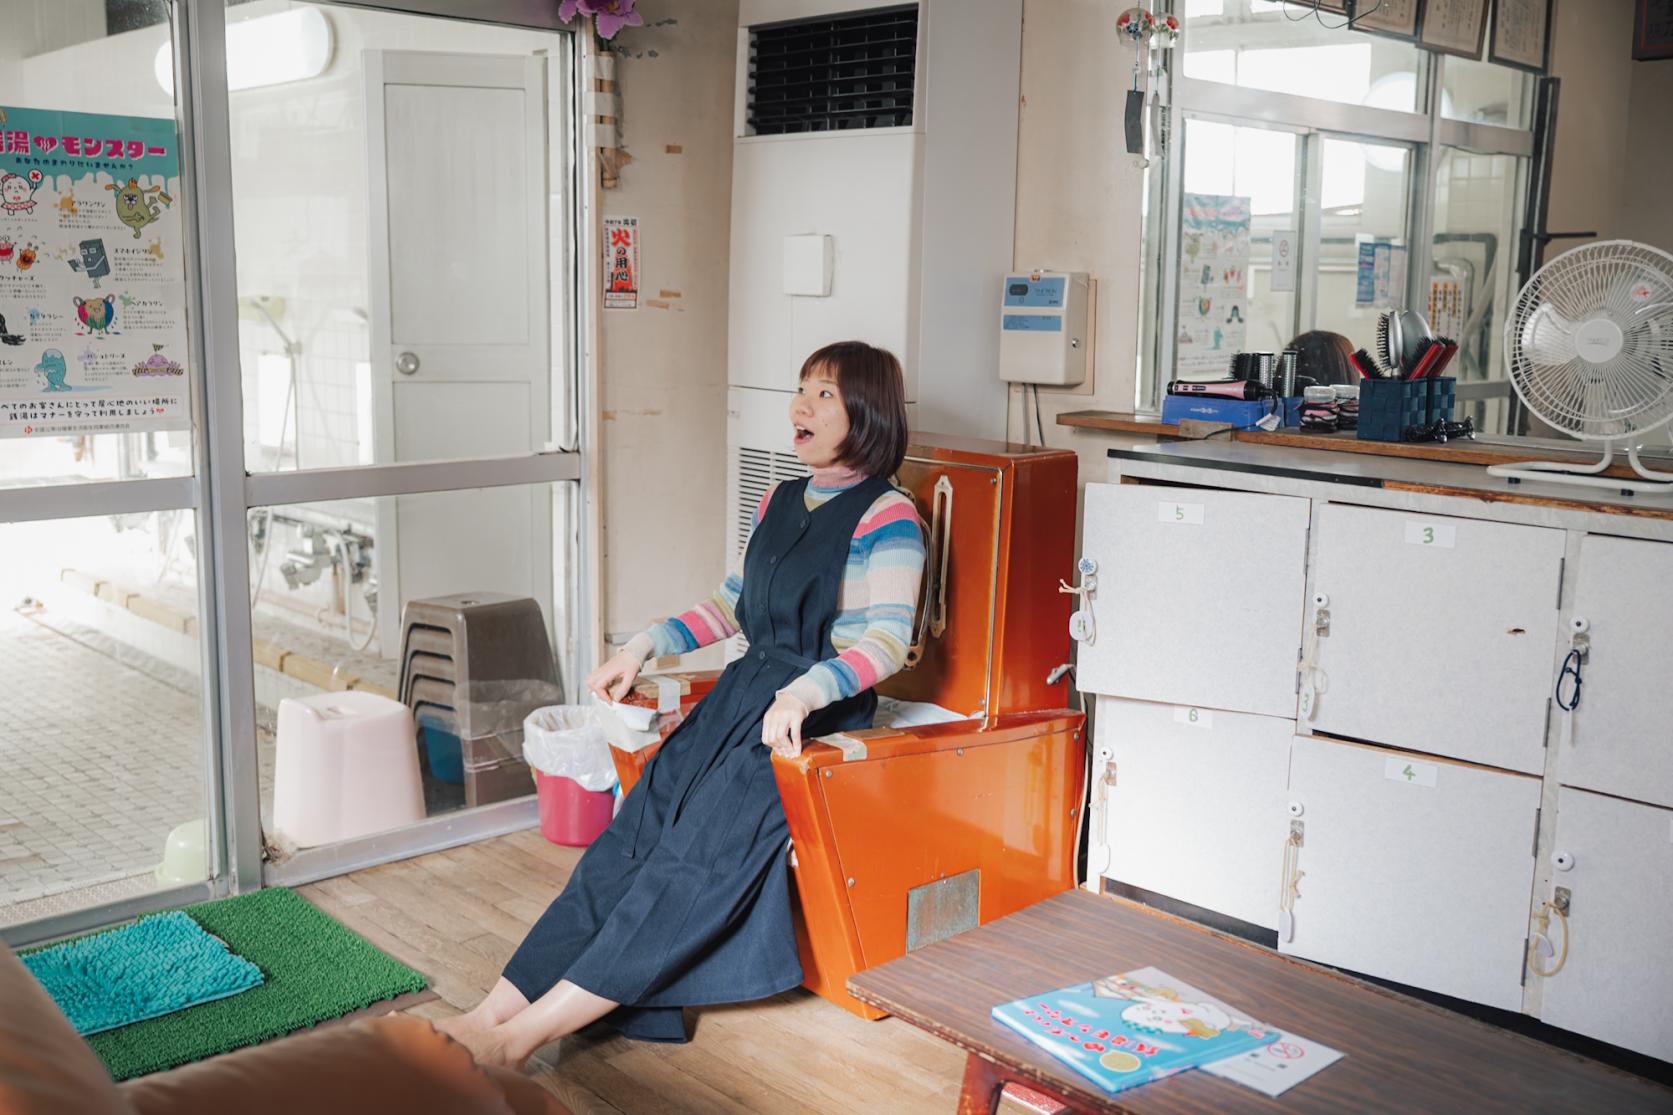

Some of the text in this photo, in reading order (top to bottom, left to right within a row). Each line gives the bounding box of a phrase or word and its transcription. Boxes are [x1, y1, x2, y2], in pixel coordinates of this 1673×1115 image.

[611, 227, 631, 281] 火の用心
[1175, 504, 1184, 520] 5
[1423, 527, 1434, 544] 3
[1189, 708, 1198, 722] 6
[1402, 764, 1416, 781] 4
